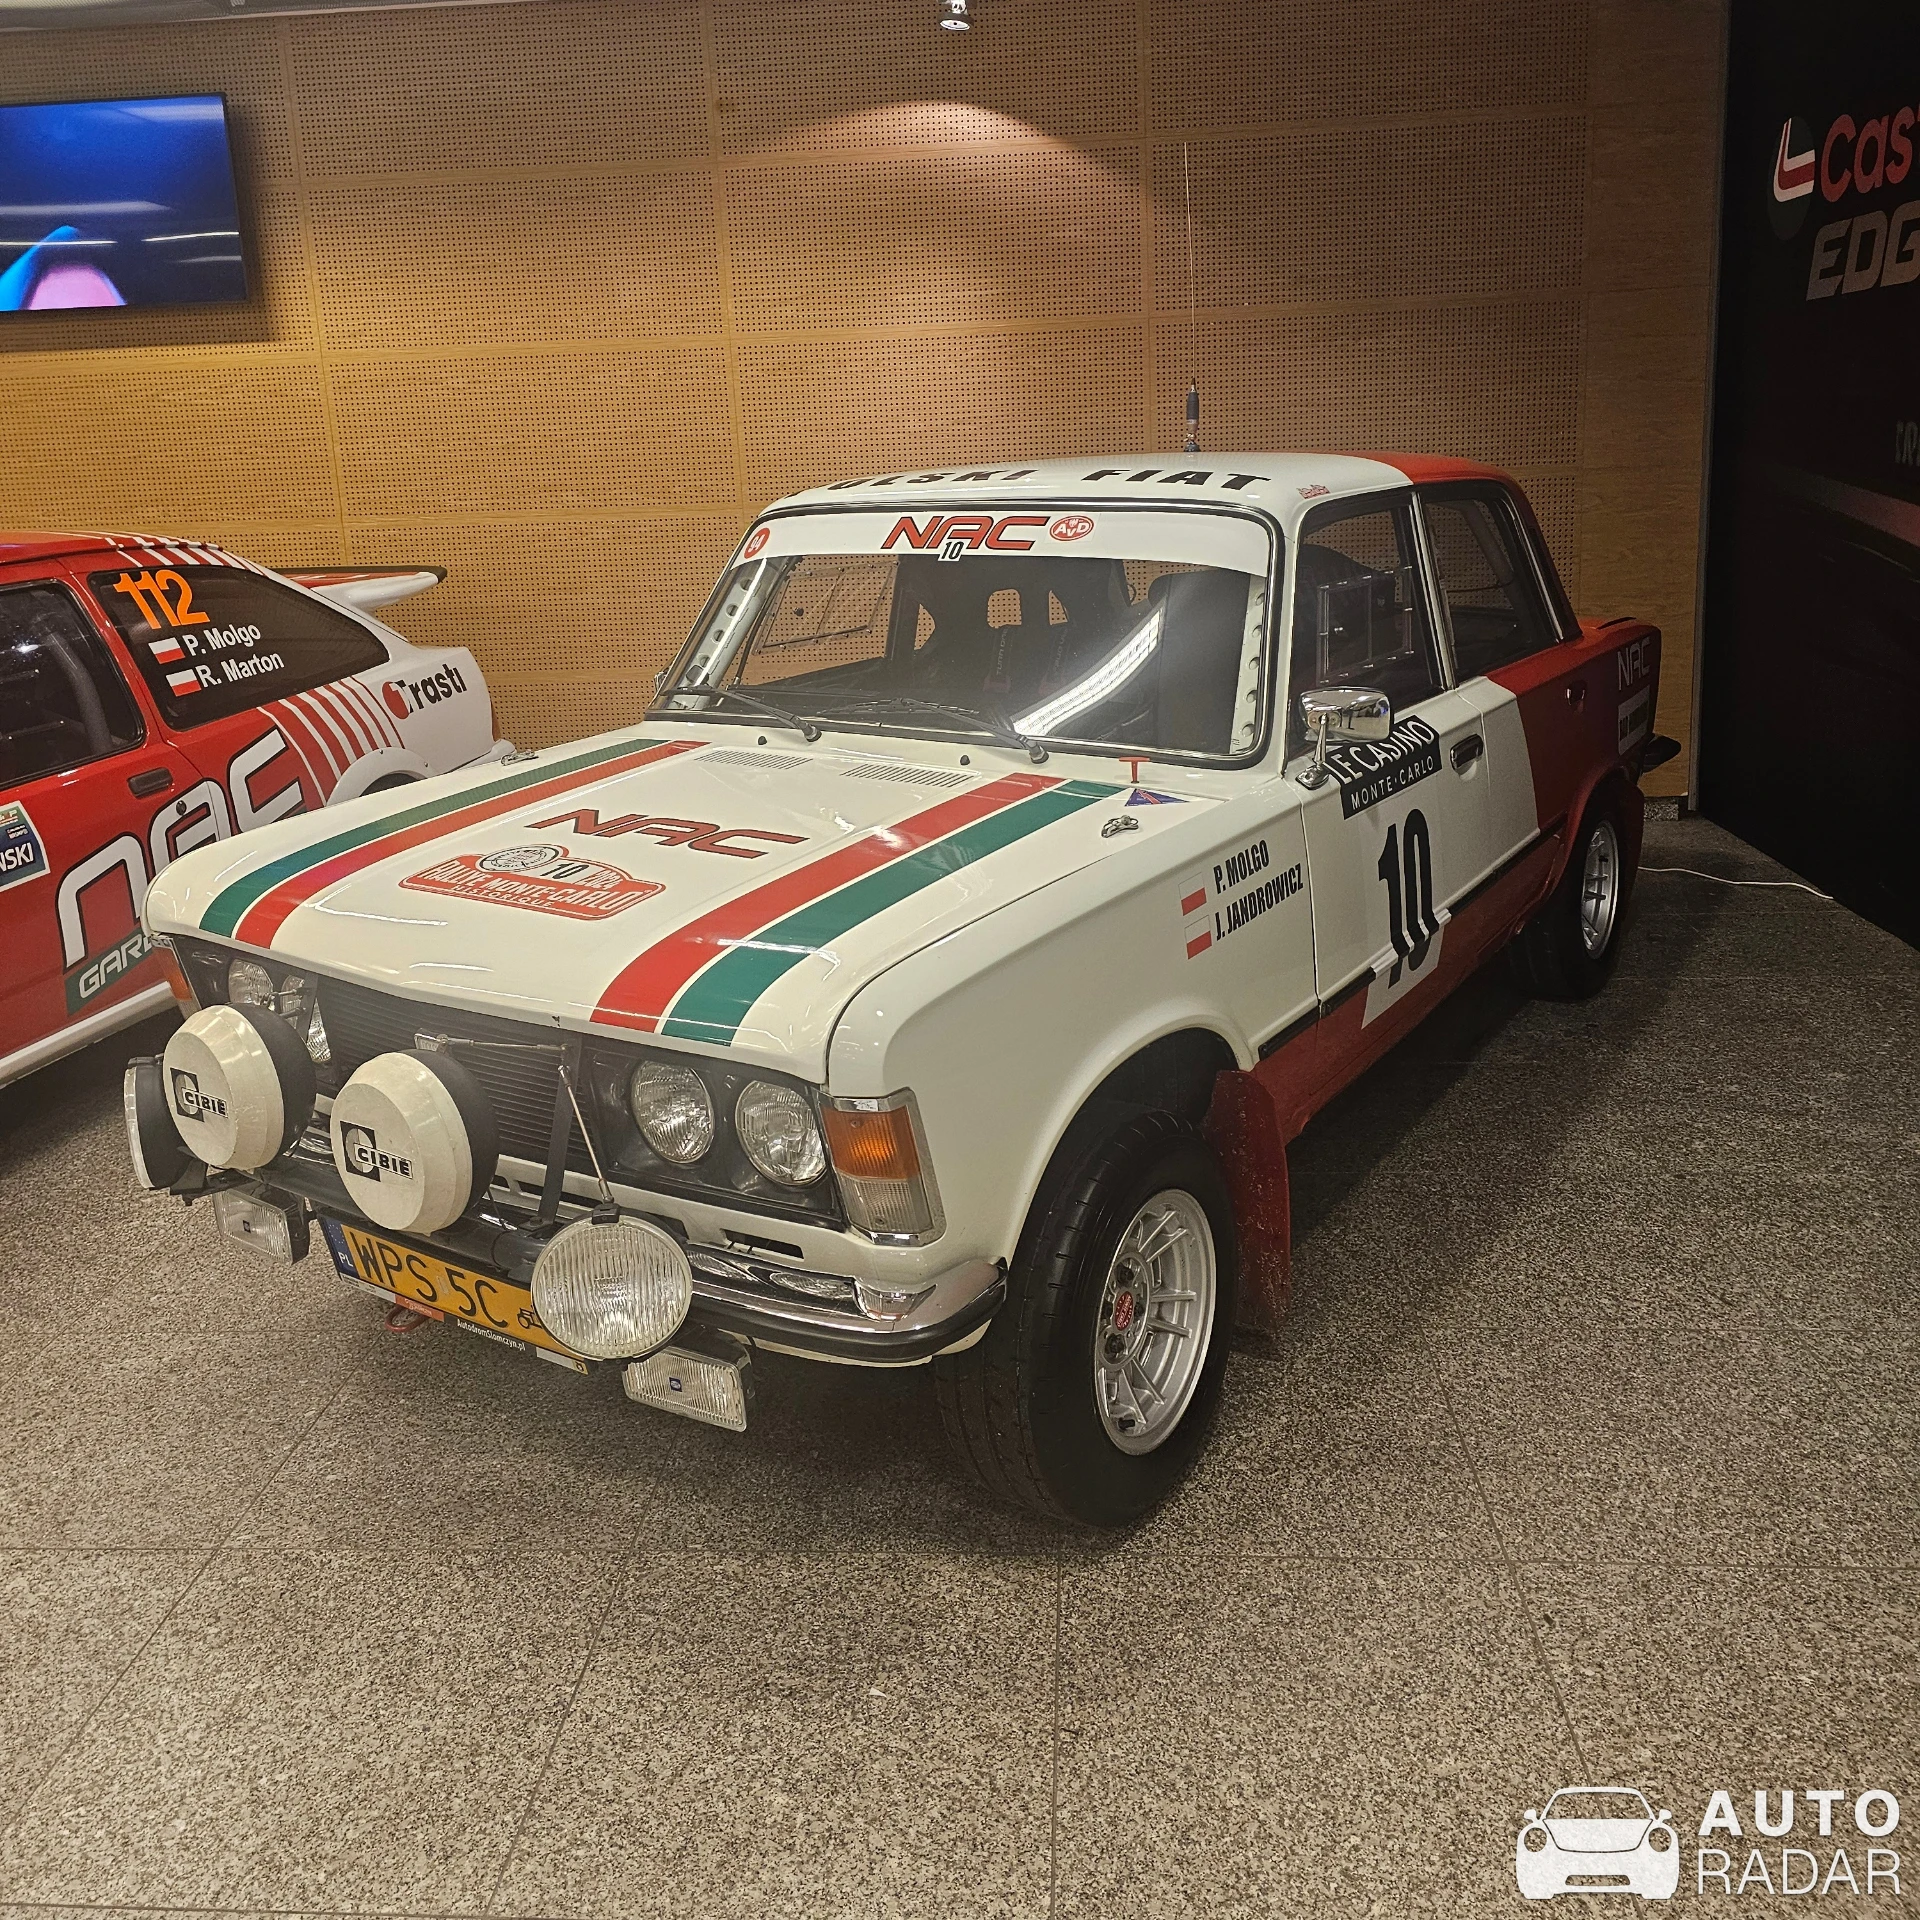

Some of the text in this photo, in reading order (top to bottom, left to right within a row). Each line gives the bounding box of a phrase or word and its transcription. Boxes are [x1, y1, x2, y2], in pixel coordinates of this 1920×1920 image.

[1820, 102, 1920, 203] Cas
[1082, 468, 1272, 490] FIAT
[880, 516, 1051, 550] NAC
[941, 541, 964, 560] 10
[113, 569, 210, 629] 112
[182, 624, 261, 656] P. Molgo
[1617, 636, 1651, 691] NAC
[195, 652, 285, 688] R. Marton
[1322, 720, 1435, 784] LE CASINO
[524, 808, 810, 859] NAC
[417, 860, 637, 910] RALLYE MONTE-CARLO
[540, 862, 590, 880] 10
[1213, 840, 1270, 895] P. MOLGO
[451, 884, 554, 908] HISTORIQUE
[1215, 863, 1304, 941] J. JANDROWICZ
[1378, 808, 1439, 989] 10
[338, 1251, 353, 1268] PL
[350, 1231, 508, 1329] WPS 5C
